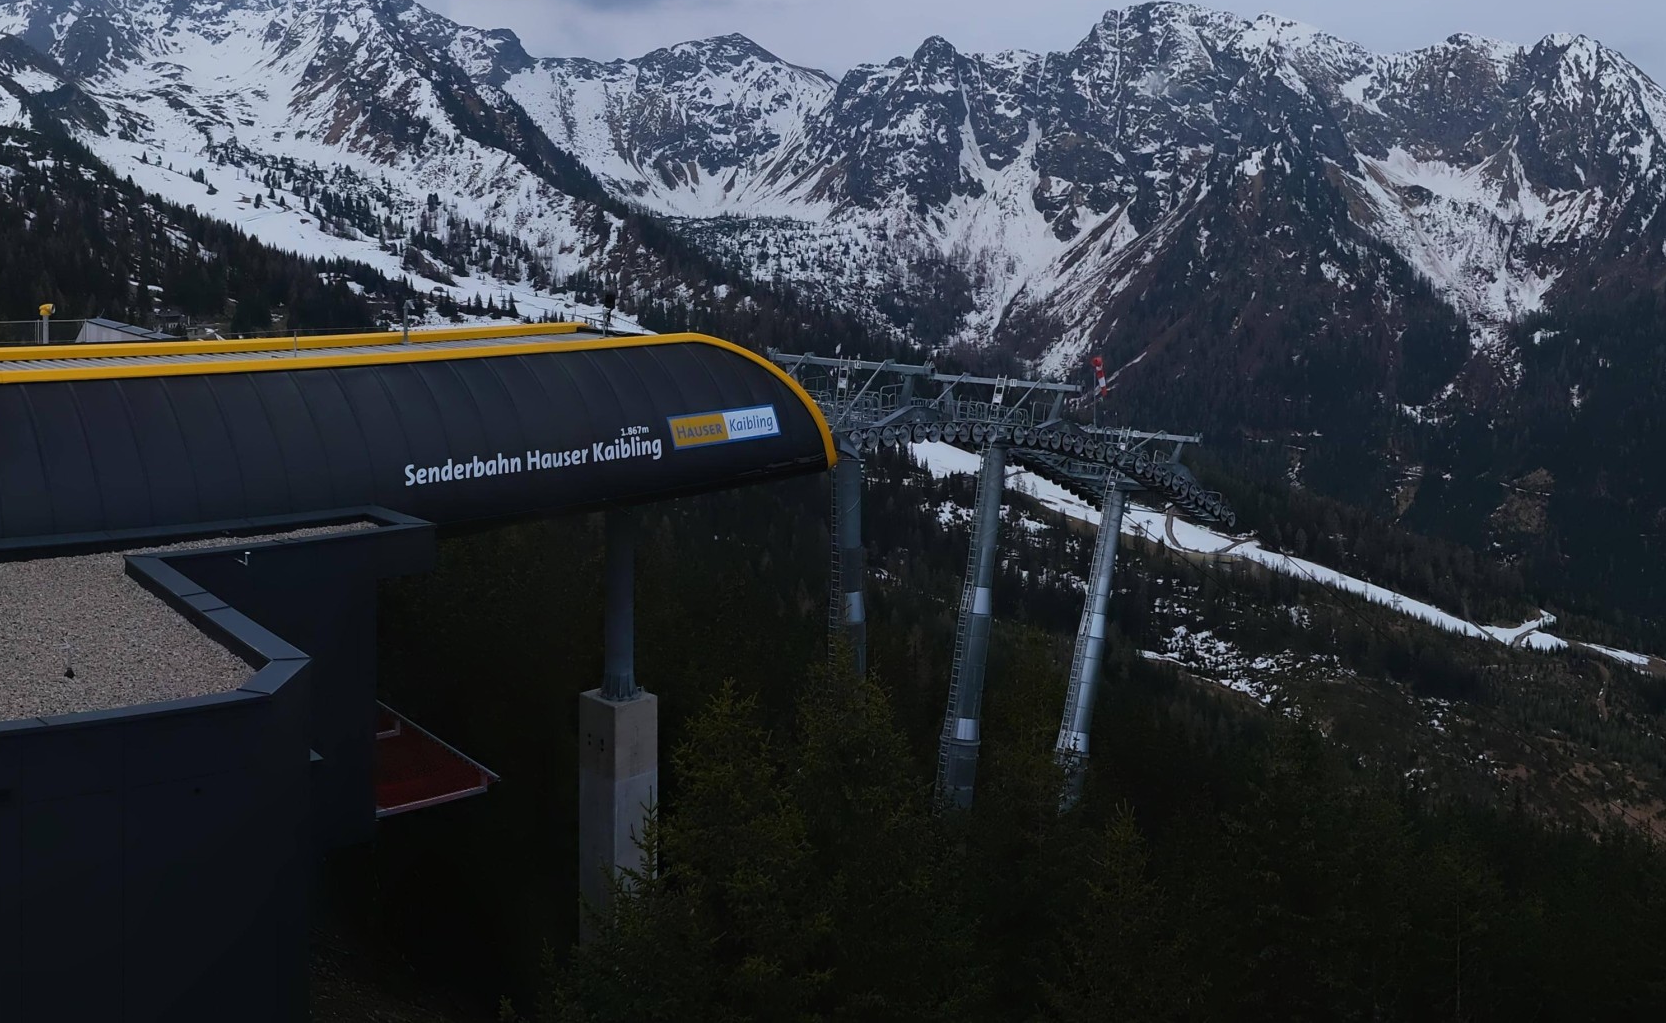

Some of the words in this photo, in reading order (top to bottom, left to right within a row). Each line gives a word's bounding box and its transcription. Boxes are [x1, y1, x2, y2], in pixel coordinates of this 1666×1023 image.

[620, 425, 650, 437] 1.867m
[675, 423, 723, 439] HAUSER
[729, 415, 774, 432] Kaibling
[404, 452, 522, 487] Senderbahn
[526, 448, 589, 471] Hauser
[593, 436, 662, 460] Kaibling
